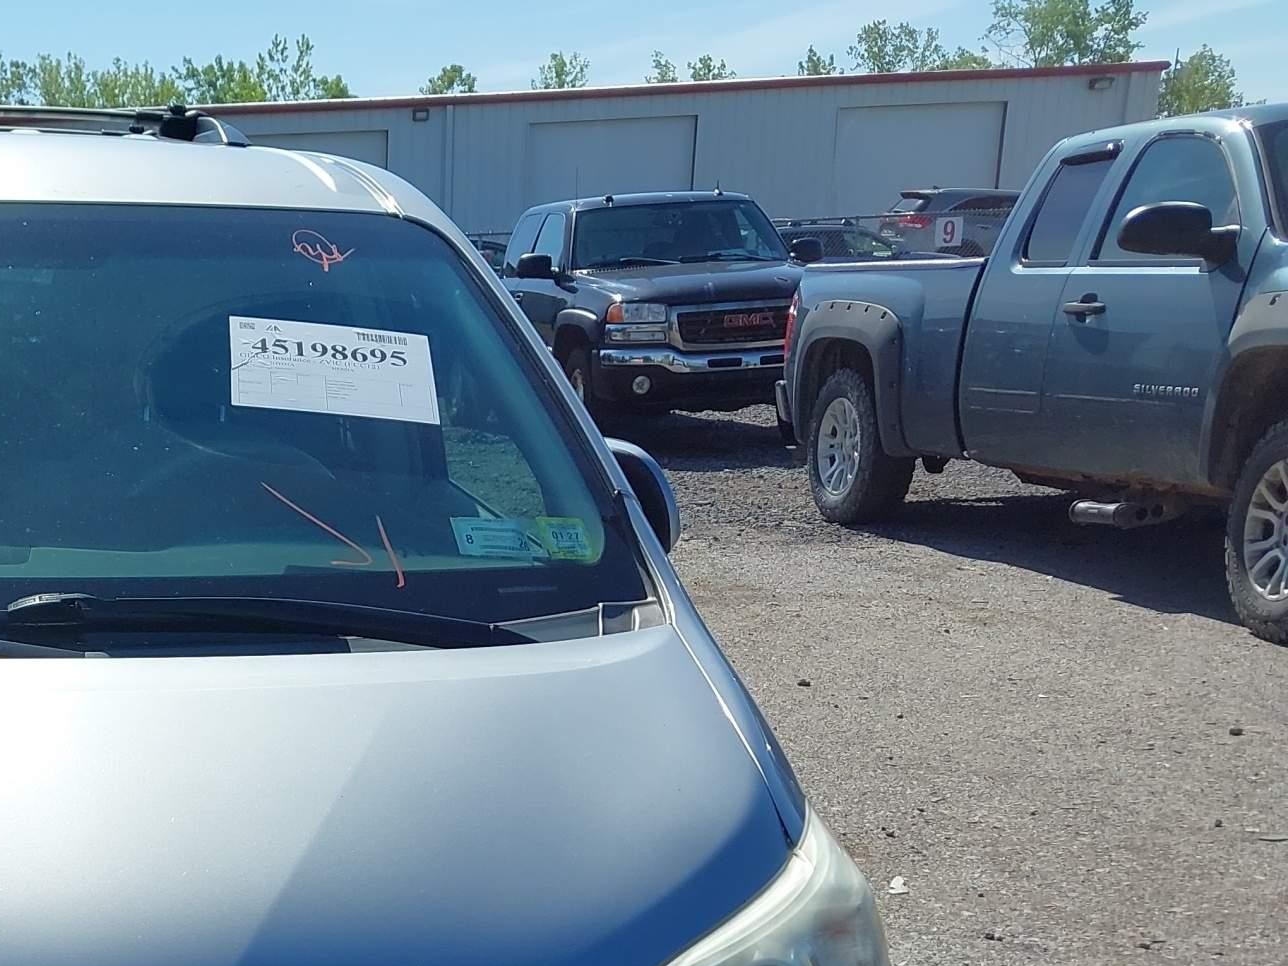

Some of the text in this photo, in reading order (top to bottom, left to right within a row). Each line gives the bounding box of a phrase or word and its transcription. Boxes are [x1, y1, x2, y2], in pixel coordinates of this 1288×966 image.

[943, 220, 956, 244] 9
[723, 311, 776, 329] GMC
[251, 336, 408, 368] 45198695
[1132, 382, 1200, 398] SILVERADO
[465, 534, 474, 545] 8
